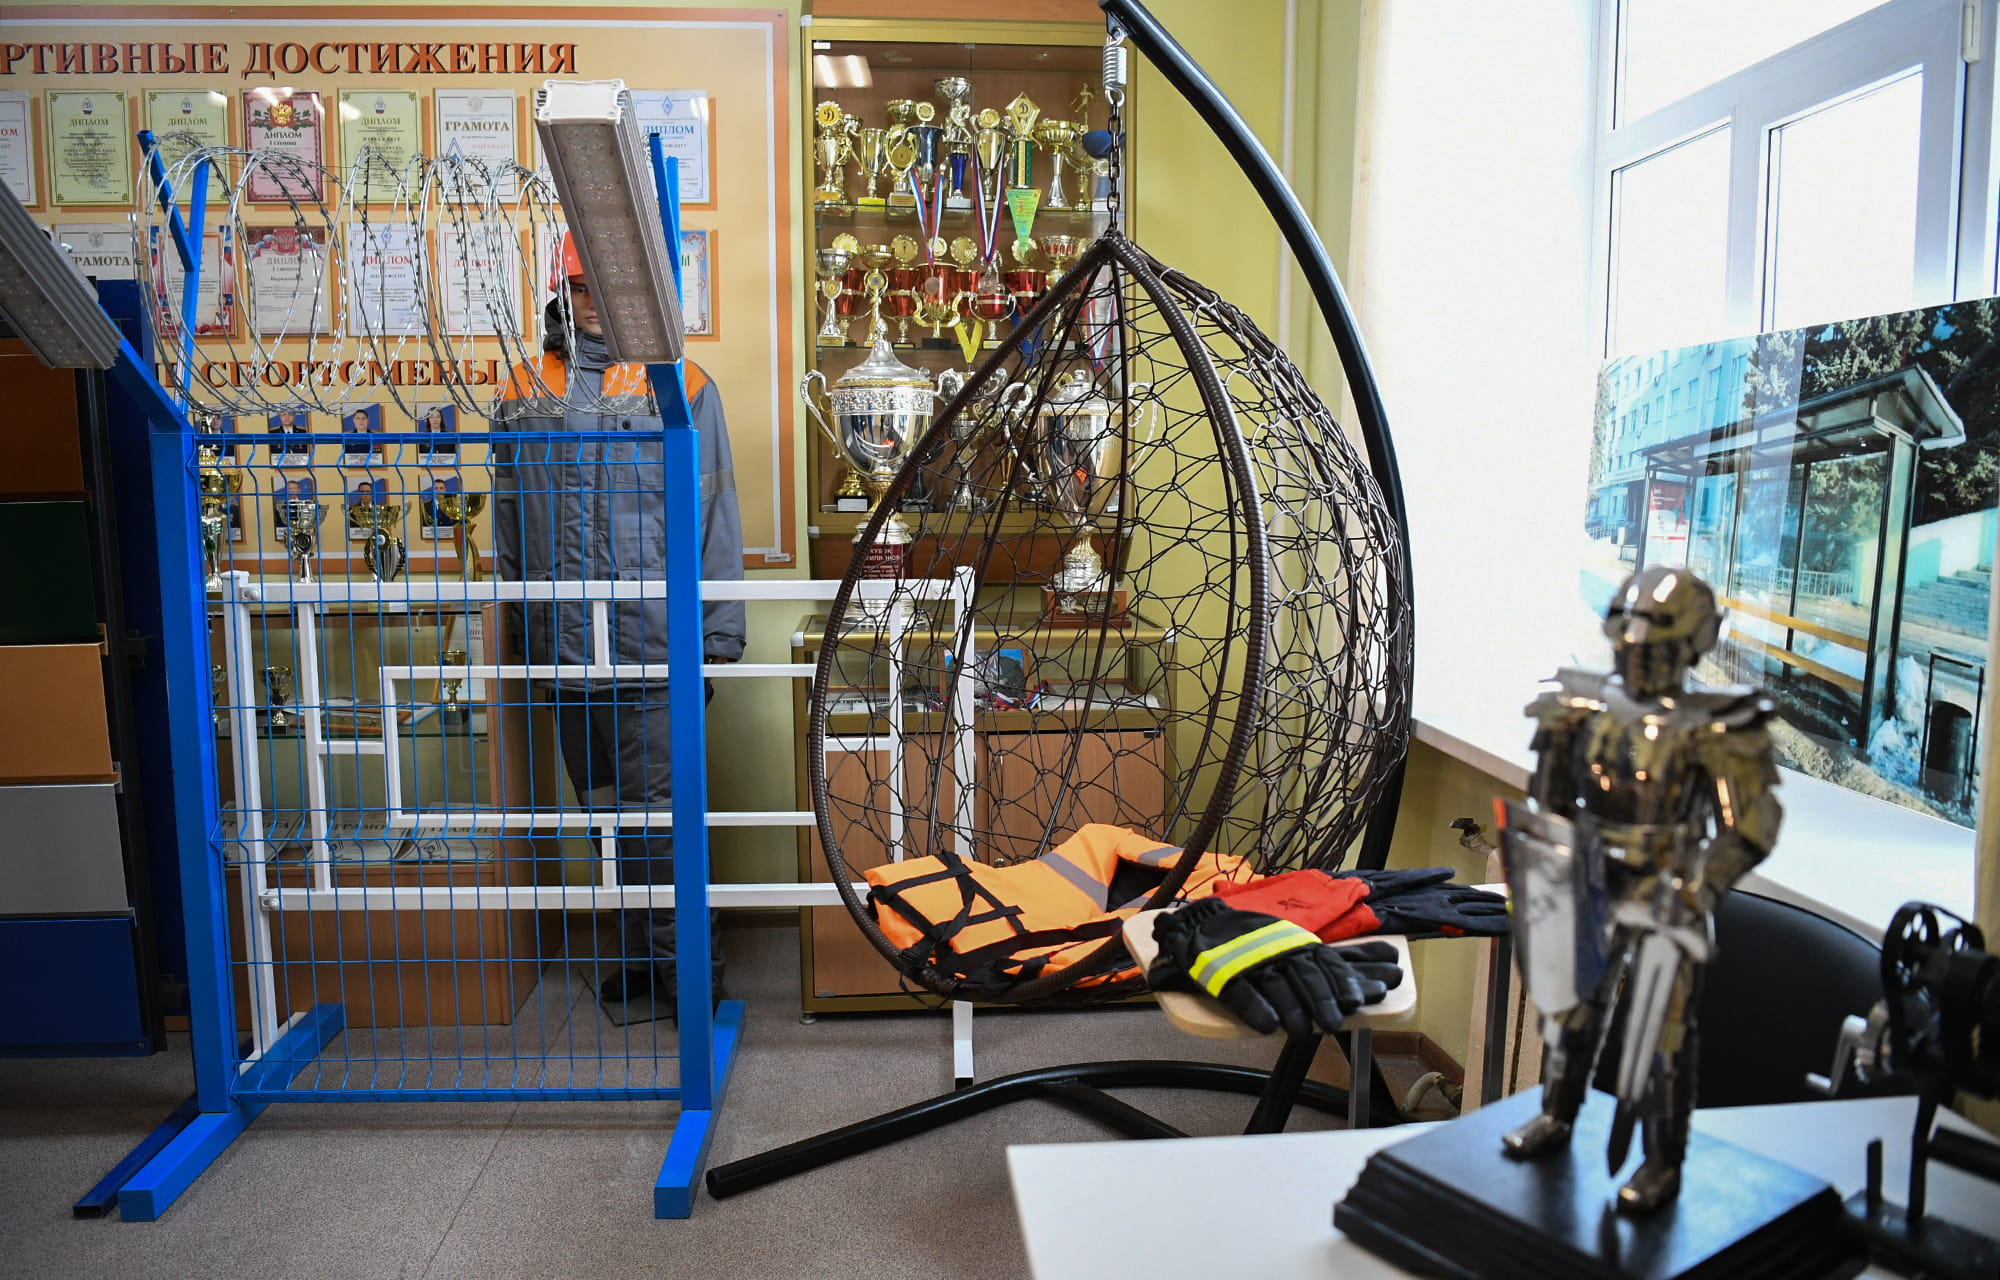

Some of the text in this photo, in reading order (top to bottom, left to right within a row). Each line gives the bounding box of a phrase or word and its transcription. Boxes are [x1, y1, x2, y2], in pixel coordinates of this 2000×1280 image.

[0, 42, 578, 80] РТИВНЫЕ ДОСТИЖЕНИЯ
[68, 117, 109, 127] ДИПЛОМ
[167, 117, 208, 126] ДИПЛОМ
[361, 117, 401, 126] ДИПЛОМ
[445, 121, 510, 132] ГРАМОТА
[642, 125, 694, 135] ДИПЛОМ
[263, 131, 302, 140] ДИПЛОМ
[72, 256, 131, 267] РАМОТА
[200, 359, 498, 387] СПОРТСМЕНЫ
